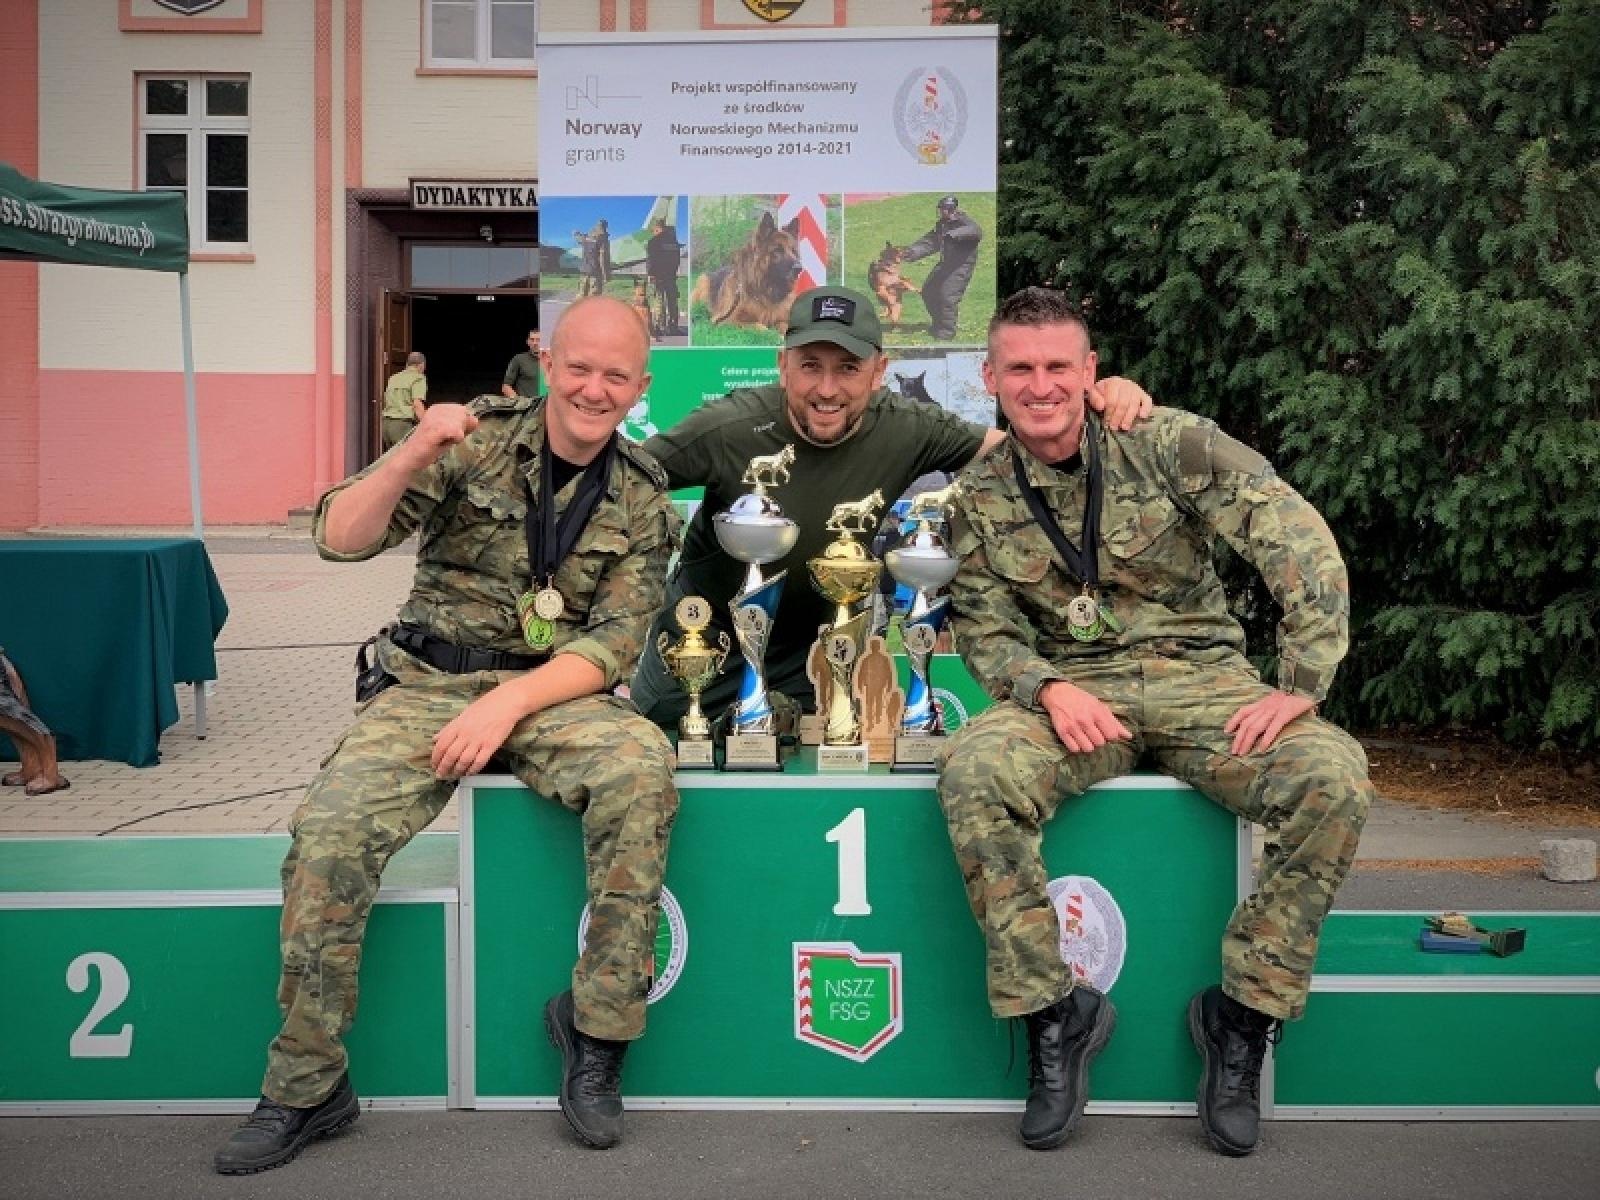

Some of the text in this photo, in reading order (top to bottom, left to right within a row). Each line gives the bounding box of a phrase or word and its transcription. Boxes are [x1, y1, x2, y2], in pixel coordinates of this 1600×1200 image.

[671, 79, 858, 97] Projekt współfinansowany
[723, 101, 804, 115] ze środków
[565, 118, 643, 140] Norway
[670, 121, 859, 139] Norweskiego Mechanizmu
[565, 146, 625, 167] grants
[680, 141, 852, 159] Finansowego 2014-2021
[416, 185, 538, 207] DYDAKTYKA
[825, 807, 872, 916] 1
[824, 979, 875, 999] NSZZ
[66, 951, 134, 1058] 2
[829, 1001, 871, 1021] FSG
